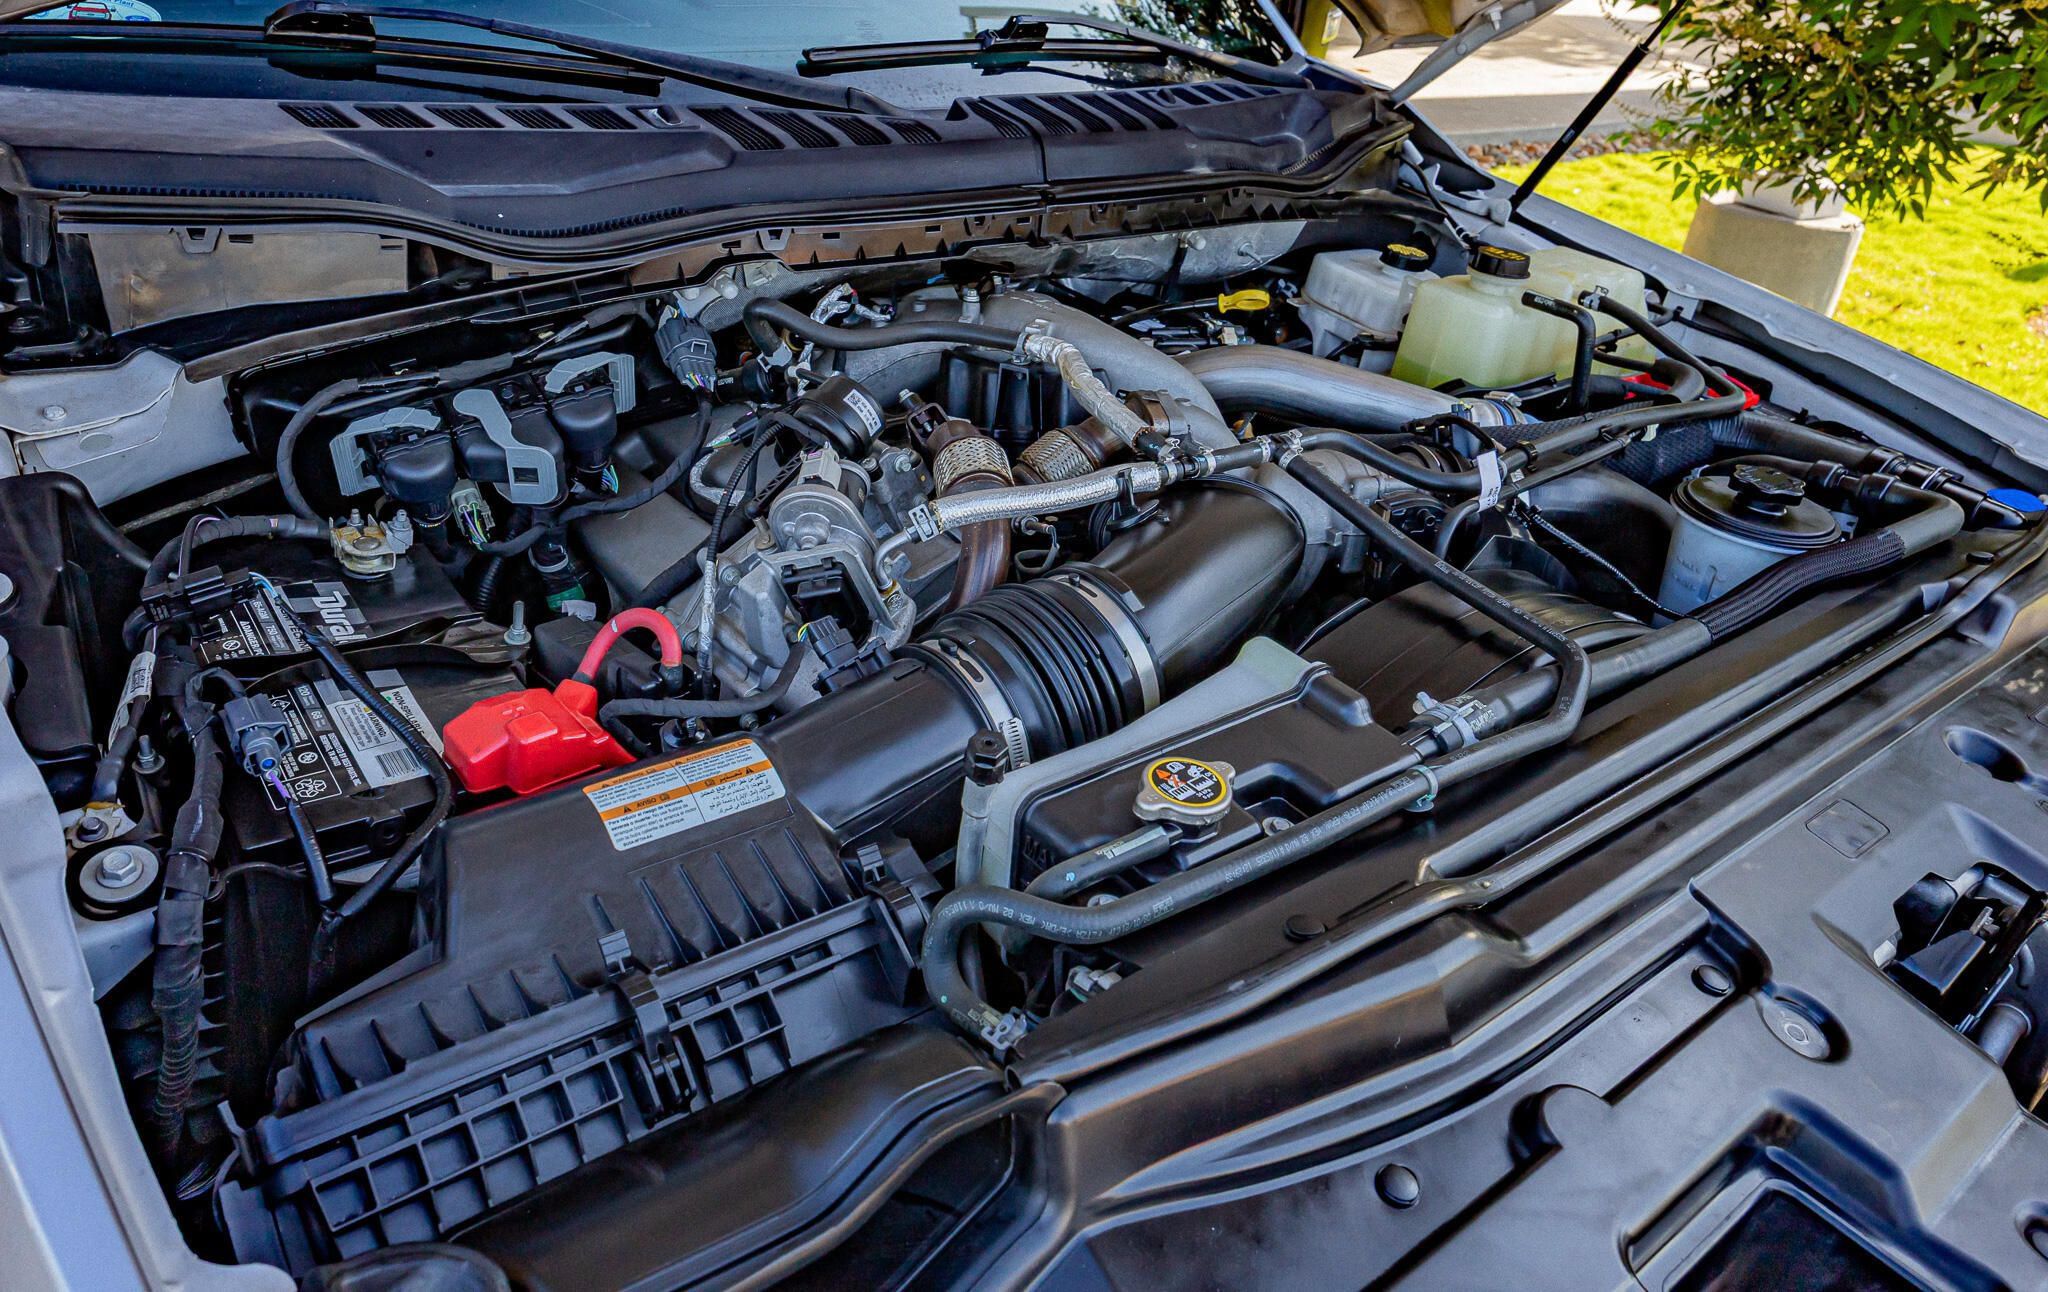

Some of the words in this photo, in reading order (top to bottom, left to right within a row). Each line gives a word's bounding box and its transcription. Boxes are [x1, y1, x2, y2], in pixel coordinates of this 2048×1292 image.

[312, 590, 368, 644] Dural
[296, 685, 311, 697] 120
[310, 709, 323, 720] 68
[366, 710, 387, 737] WARNING:
[634, 796, 657, 808] AVISO
